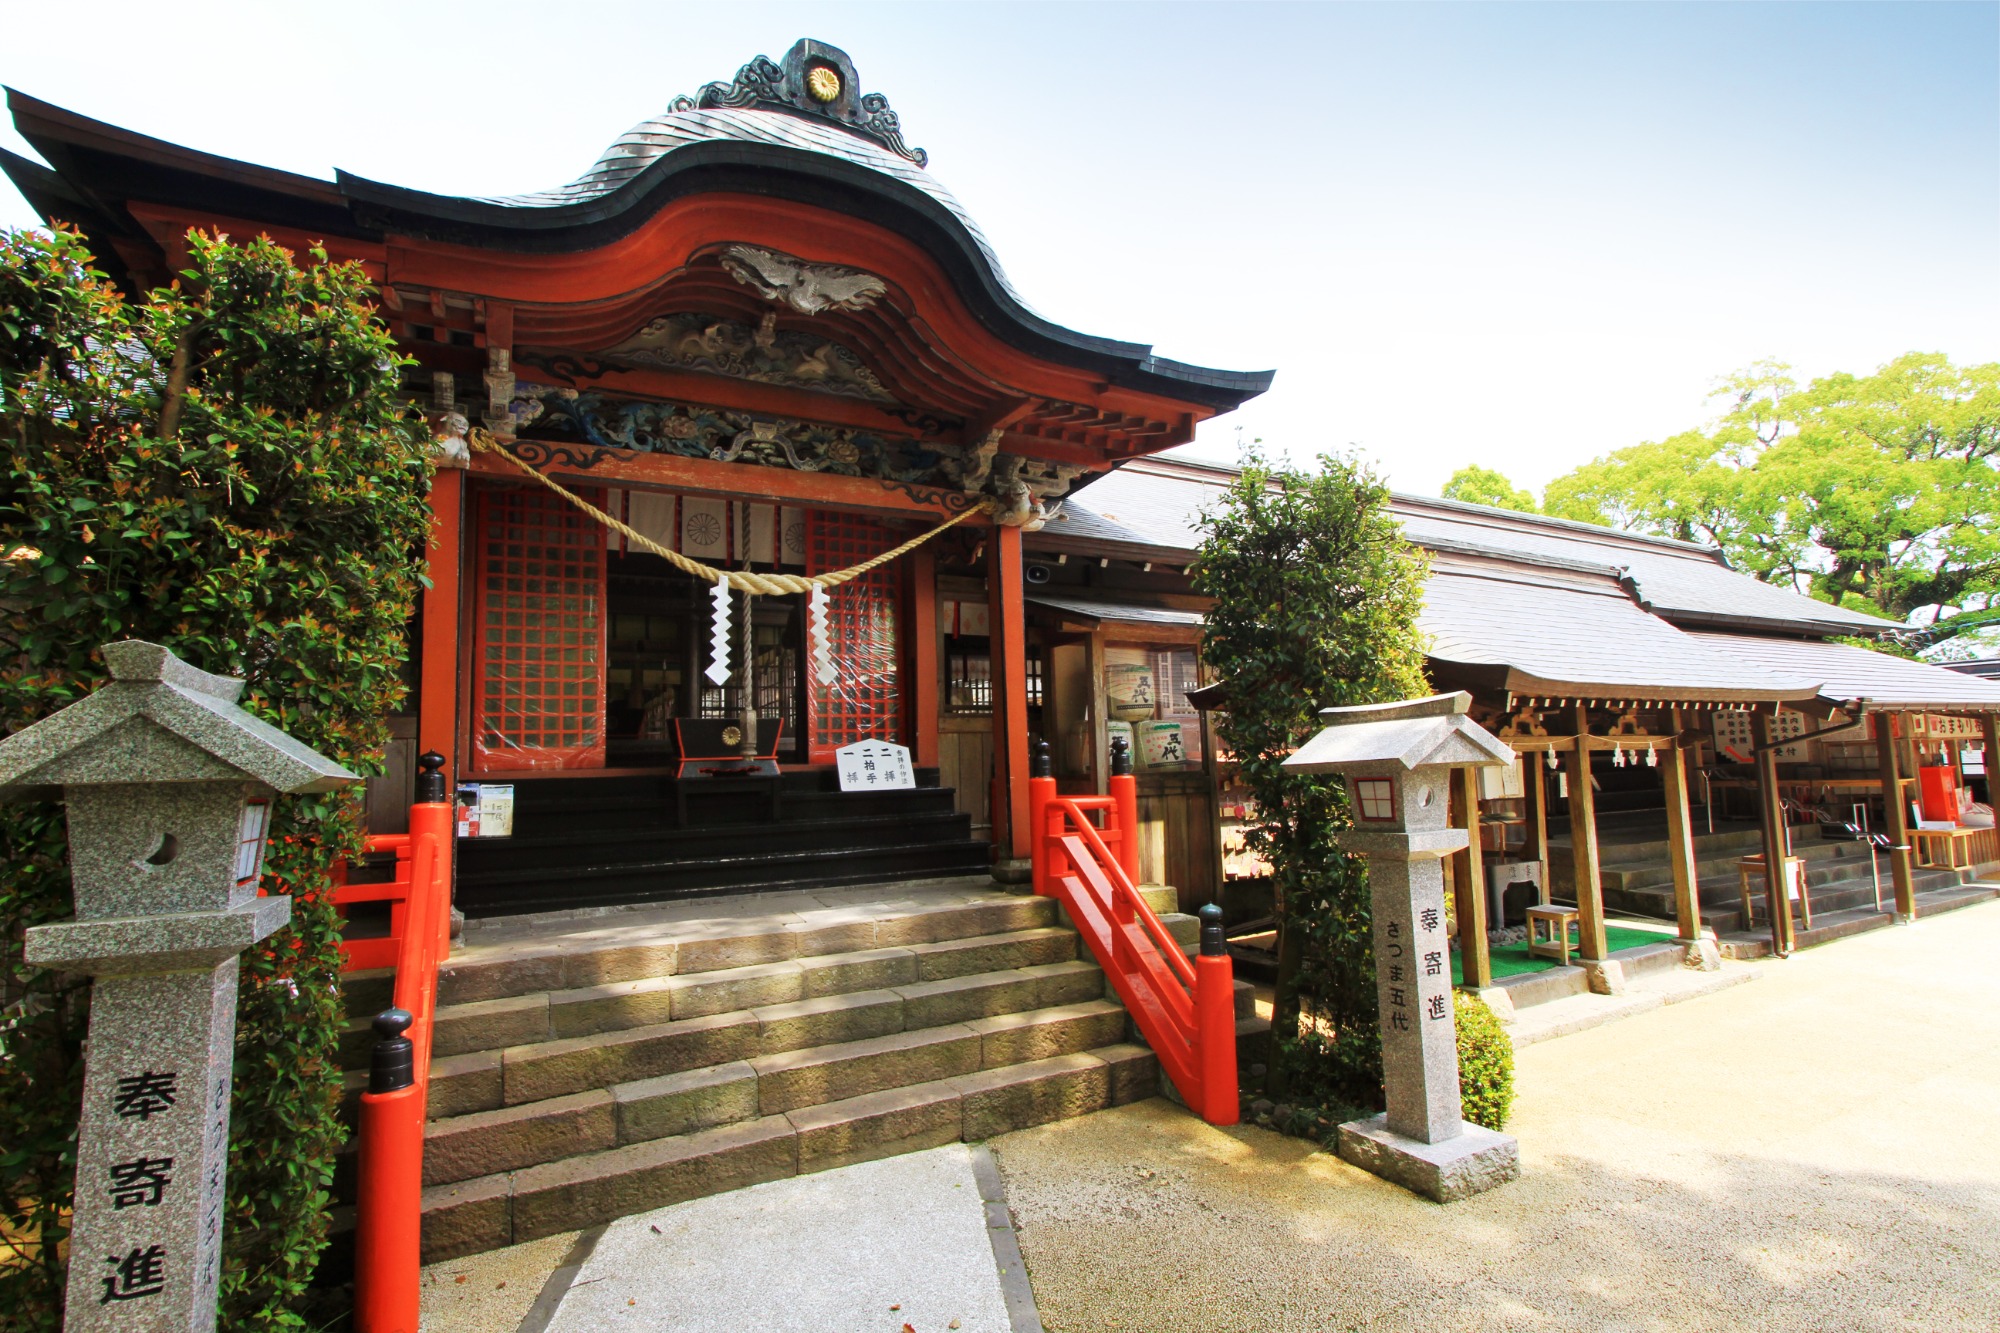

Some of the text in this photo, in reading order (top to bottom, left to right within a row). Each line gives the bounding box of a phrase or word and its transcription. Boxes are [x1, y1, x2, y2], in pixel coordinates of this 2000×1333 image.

[862, 748, 878, 784] 二拍手
[1162, 733, 1181, 760] 五代
[1386, 920, 1409, 1031] さつま五代
[1420, 908, 1446, 1021] 奉寄進
[100, 1070, 177, 1306] 奉寄進
